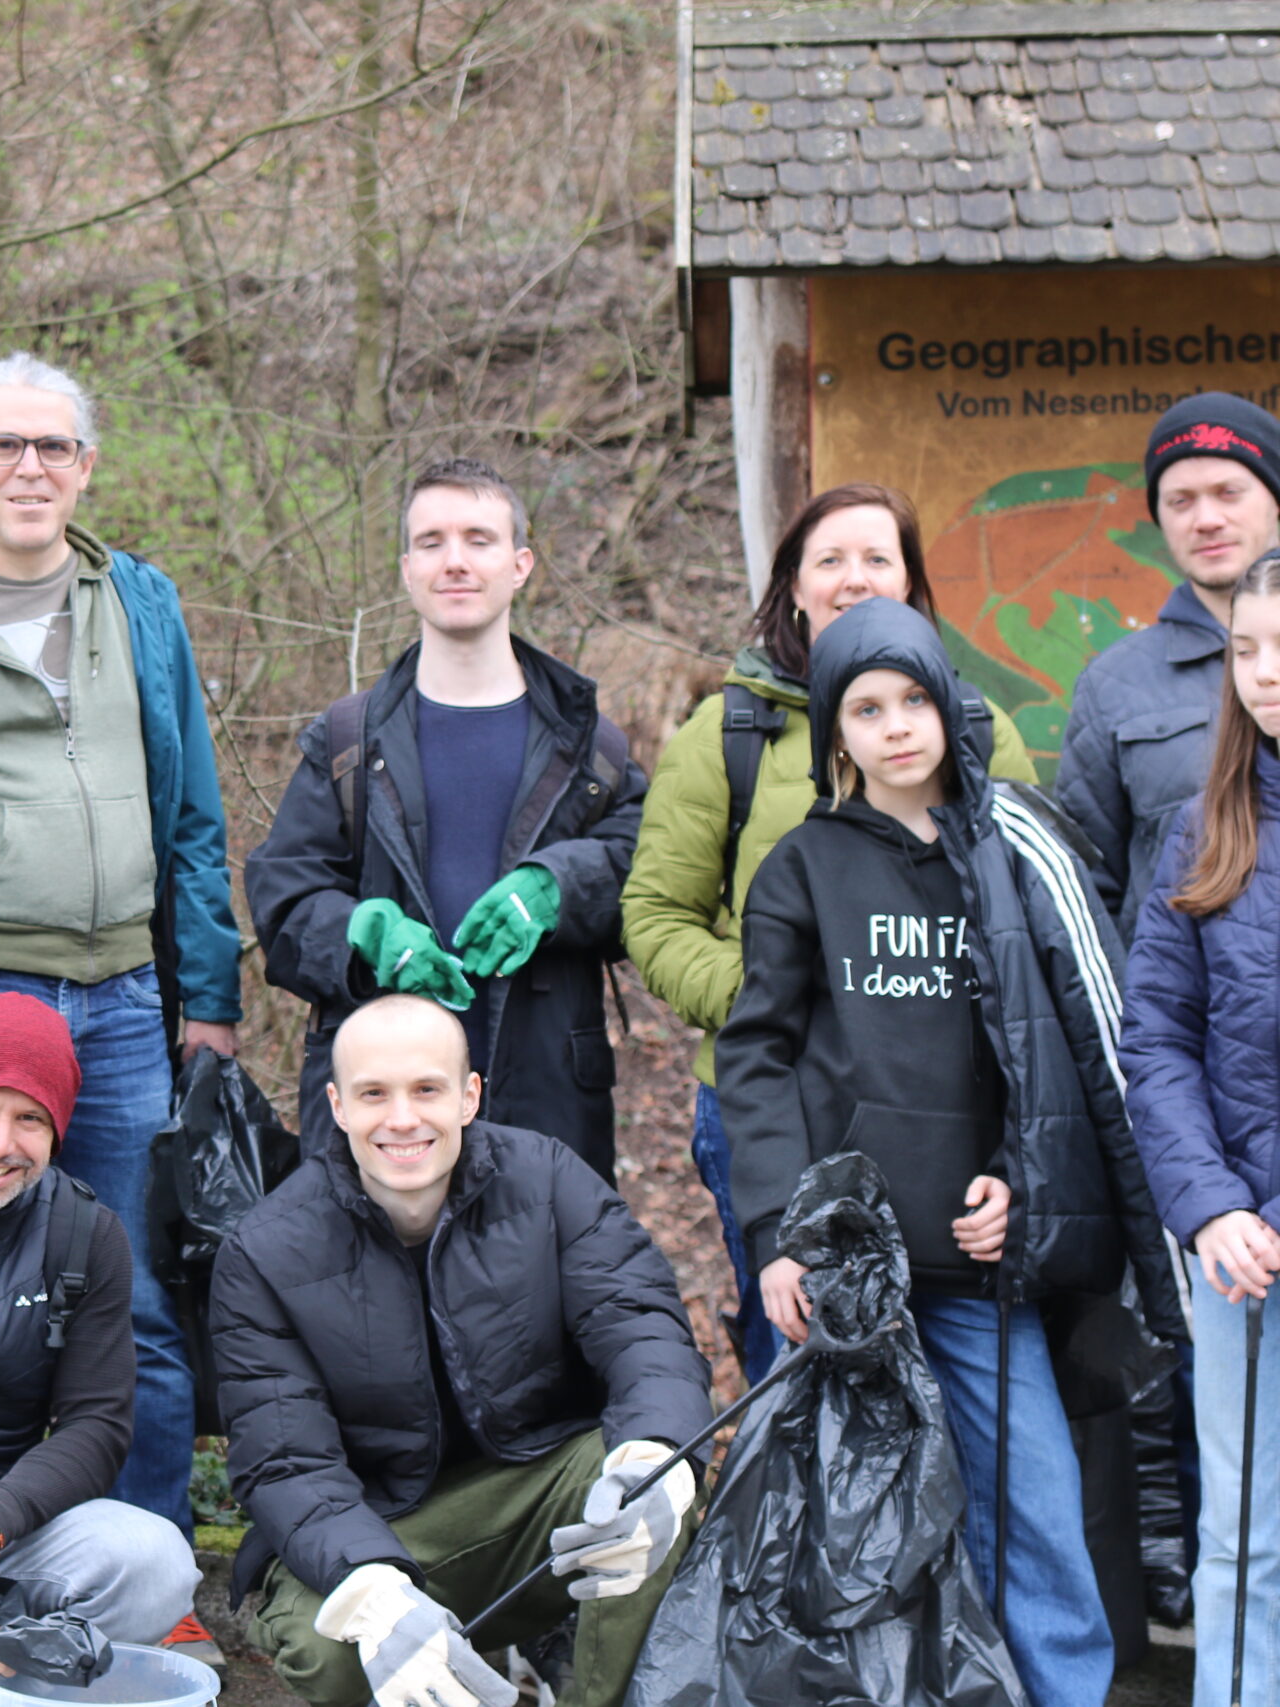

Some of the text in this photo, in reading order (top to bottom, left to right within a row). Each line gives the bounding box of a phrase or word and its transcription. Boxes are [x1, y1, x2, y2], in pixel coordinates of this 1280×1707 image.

[937, 390, 1011, 418] Vom
[1022, 385, 1204, 416] Nesenba
[870, 914, 929, 958] FUN
[842, 957, 855, 991] I
[863, 963, 954, 999] don't
